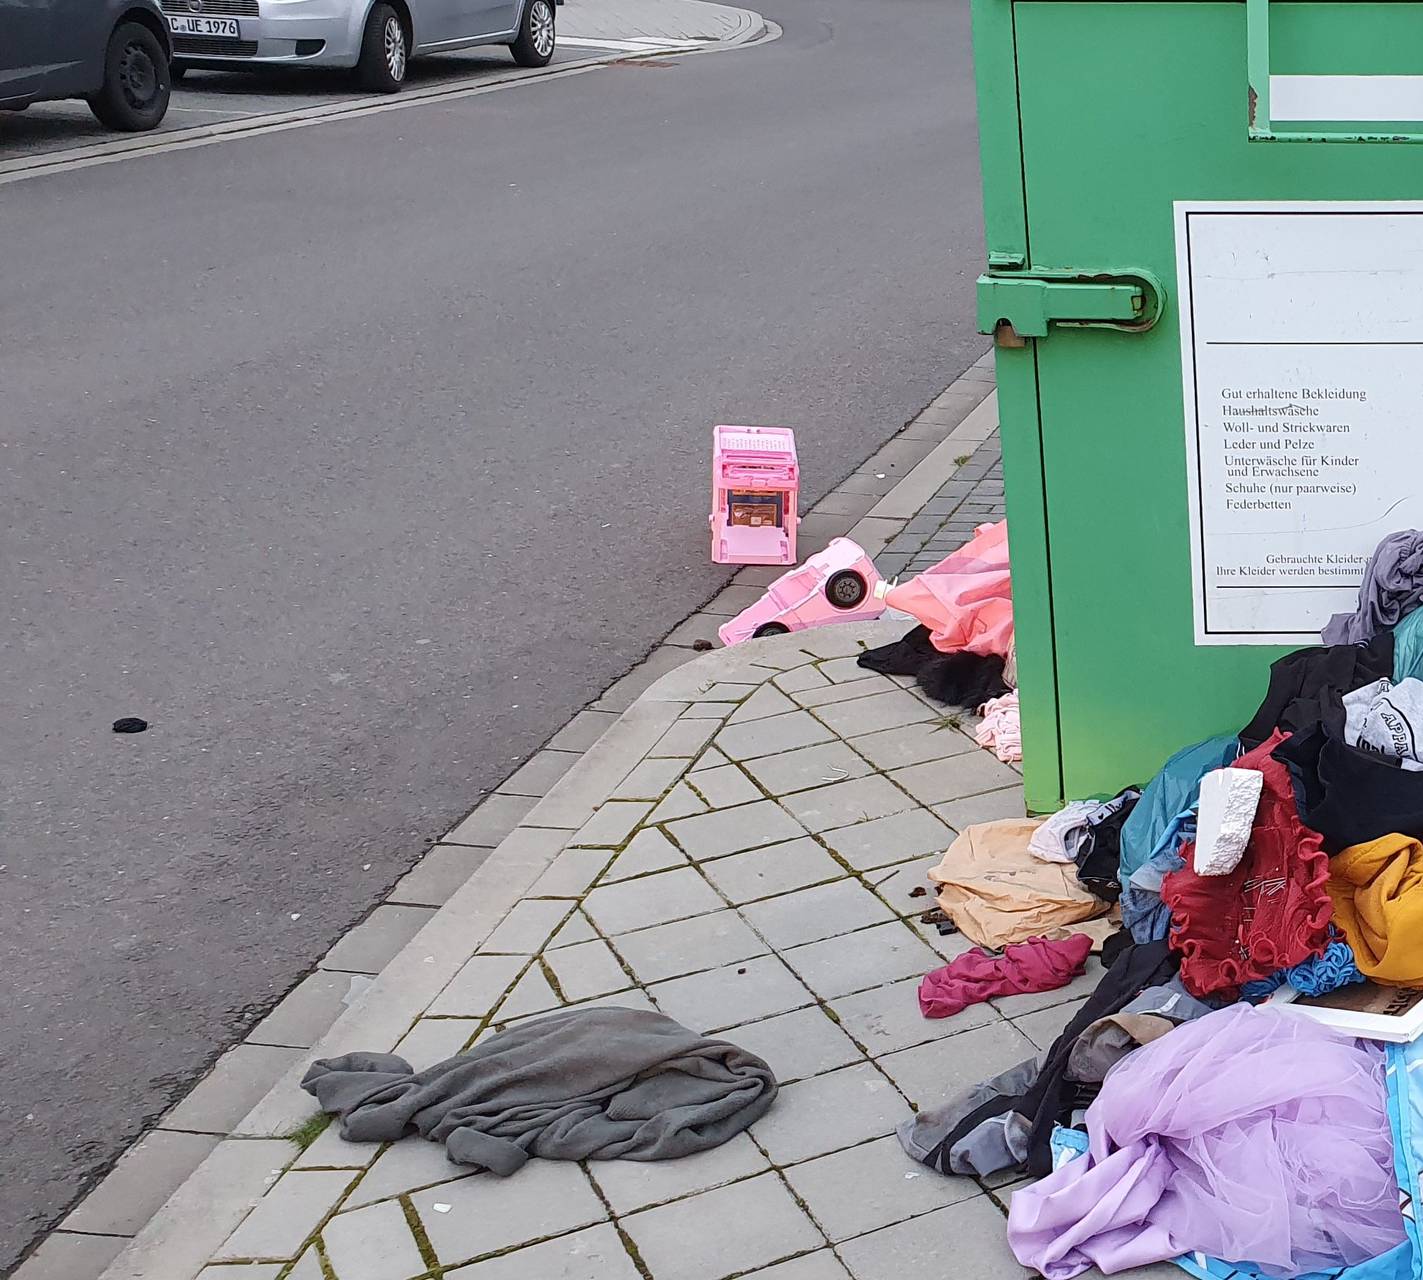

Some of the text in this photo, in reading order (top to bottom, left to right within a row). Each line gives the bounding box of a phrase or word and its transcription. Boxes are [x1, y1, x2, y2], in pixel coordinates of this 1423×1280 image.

[170, 17, 236, 34] C UE 1976
[1221, 388, 1367, 402] Gut erhaltene Bekleidung
[1222, 403, 1319, 416] Haushaltswäsche
[1223, 421, 1350, 433] Woll- und Strickwaren
[1223, 438, 1315, 450] Leder und Pelze
[1224, 455, 1360, 466] Unterwäsche für Kinder
[1227, 466, 1319, 477] und Erwachsene
[1225, 482, 1357, 496] Schuhe (nur paarweise)
[1226, 498, 1292, 510] Federbetten
[1266, 553, 1323, 564] Gebrauchte
[1326, 553, 1363, 564] Kleider
[1216, 565, 1364, 576] Ihre Kleider werden bestimmt
[1380, 712, 1409, 757] APPA
